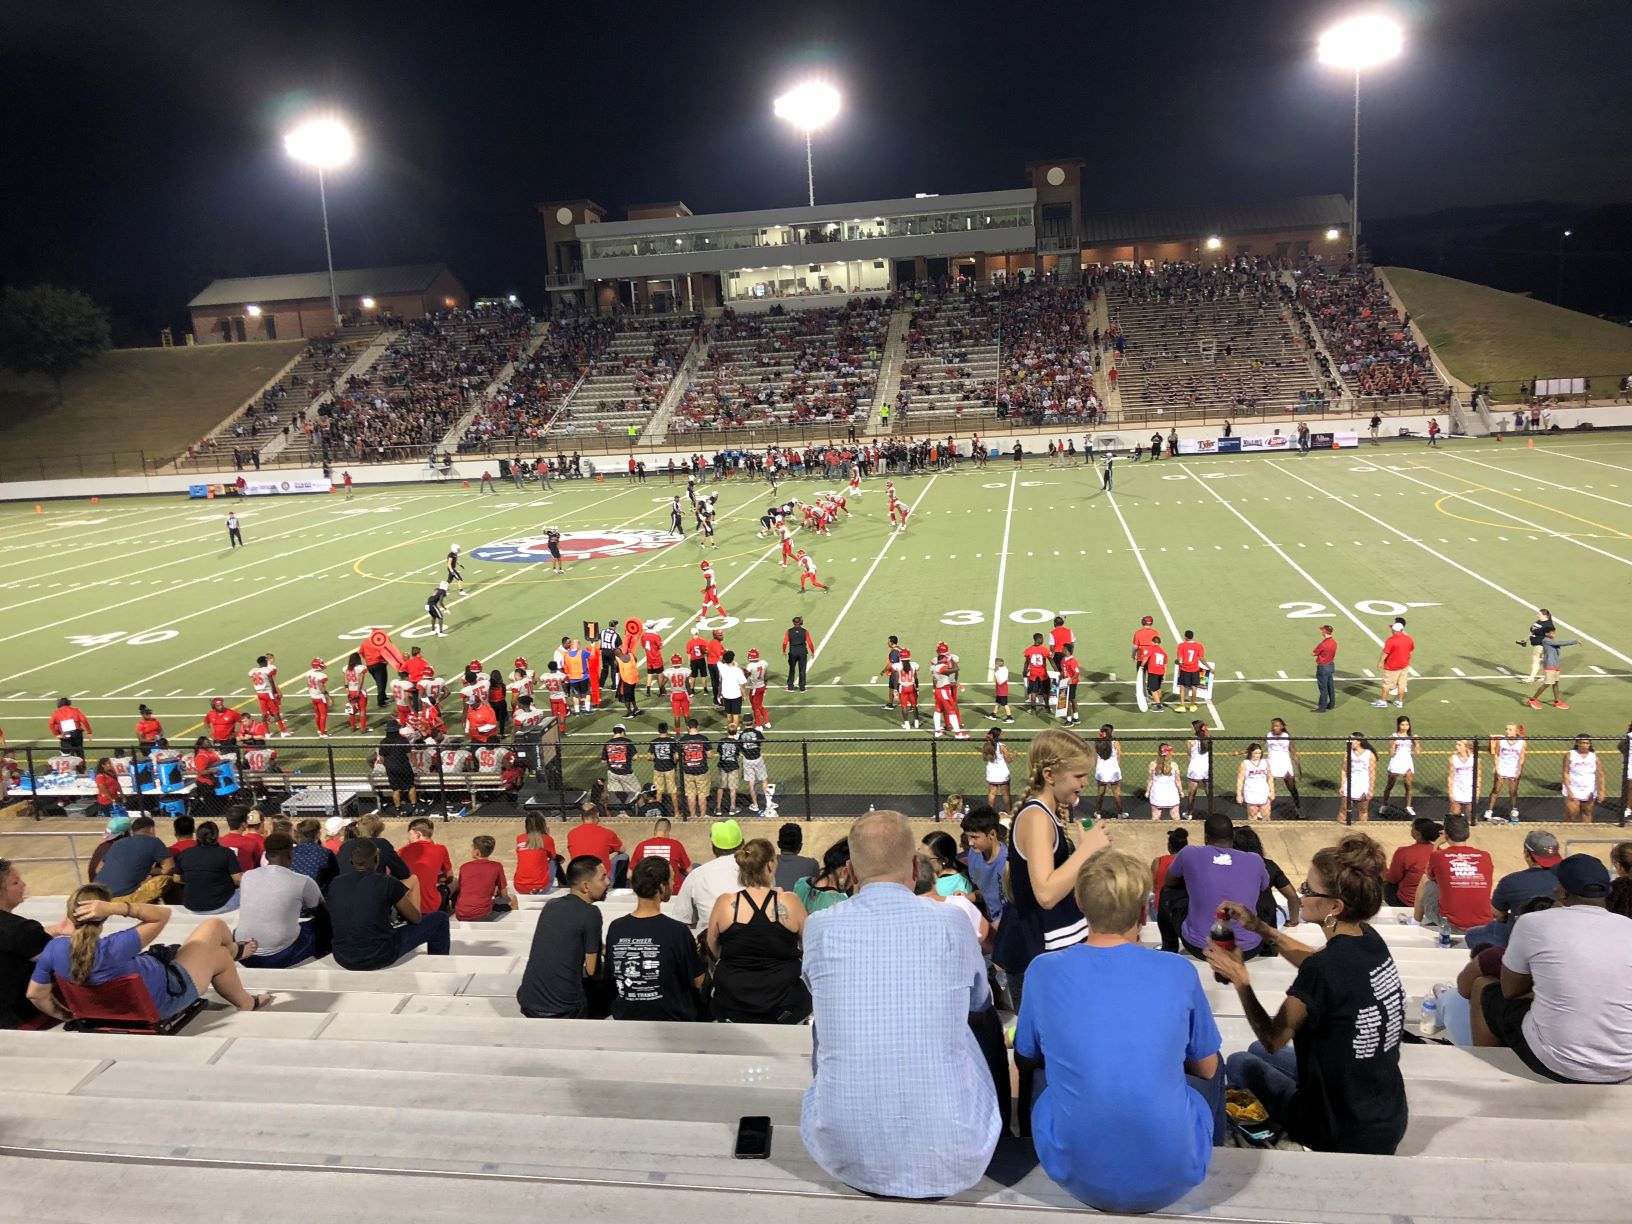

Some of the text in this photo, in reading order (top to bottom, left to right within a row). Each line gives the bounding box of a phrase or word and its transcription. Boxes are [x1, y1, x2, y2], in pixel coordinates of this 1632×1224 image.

[939, 608, 1056, 626] 30
[588, 623, 595, 639] 1
[645, 640, 651, 651] 4
[694, 646, 701, 657] 5
[1031, 654, 1043, 666] 43
[1188, 649, 1195, 662] 7
[546, 677, 560, 691] 23
[446, 751, 455, 766] 9
